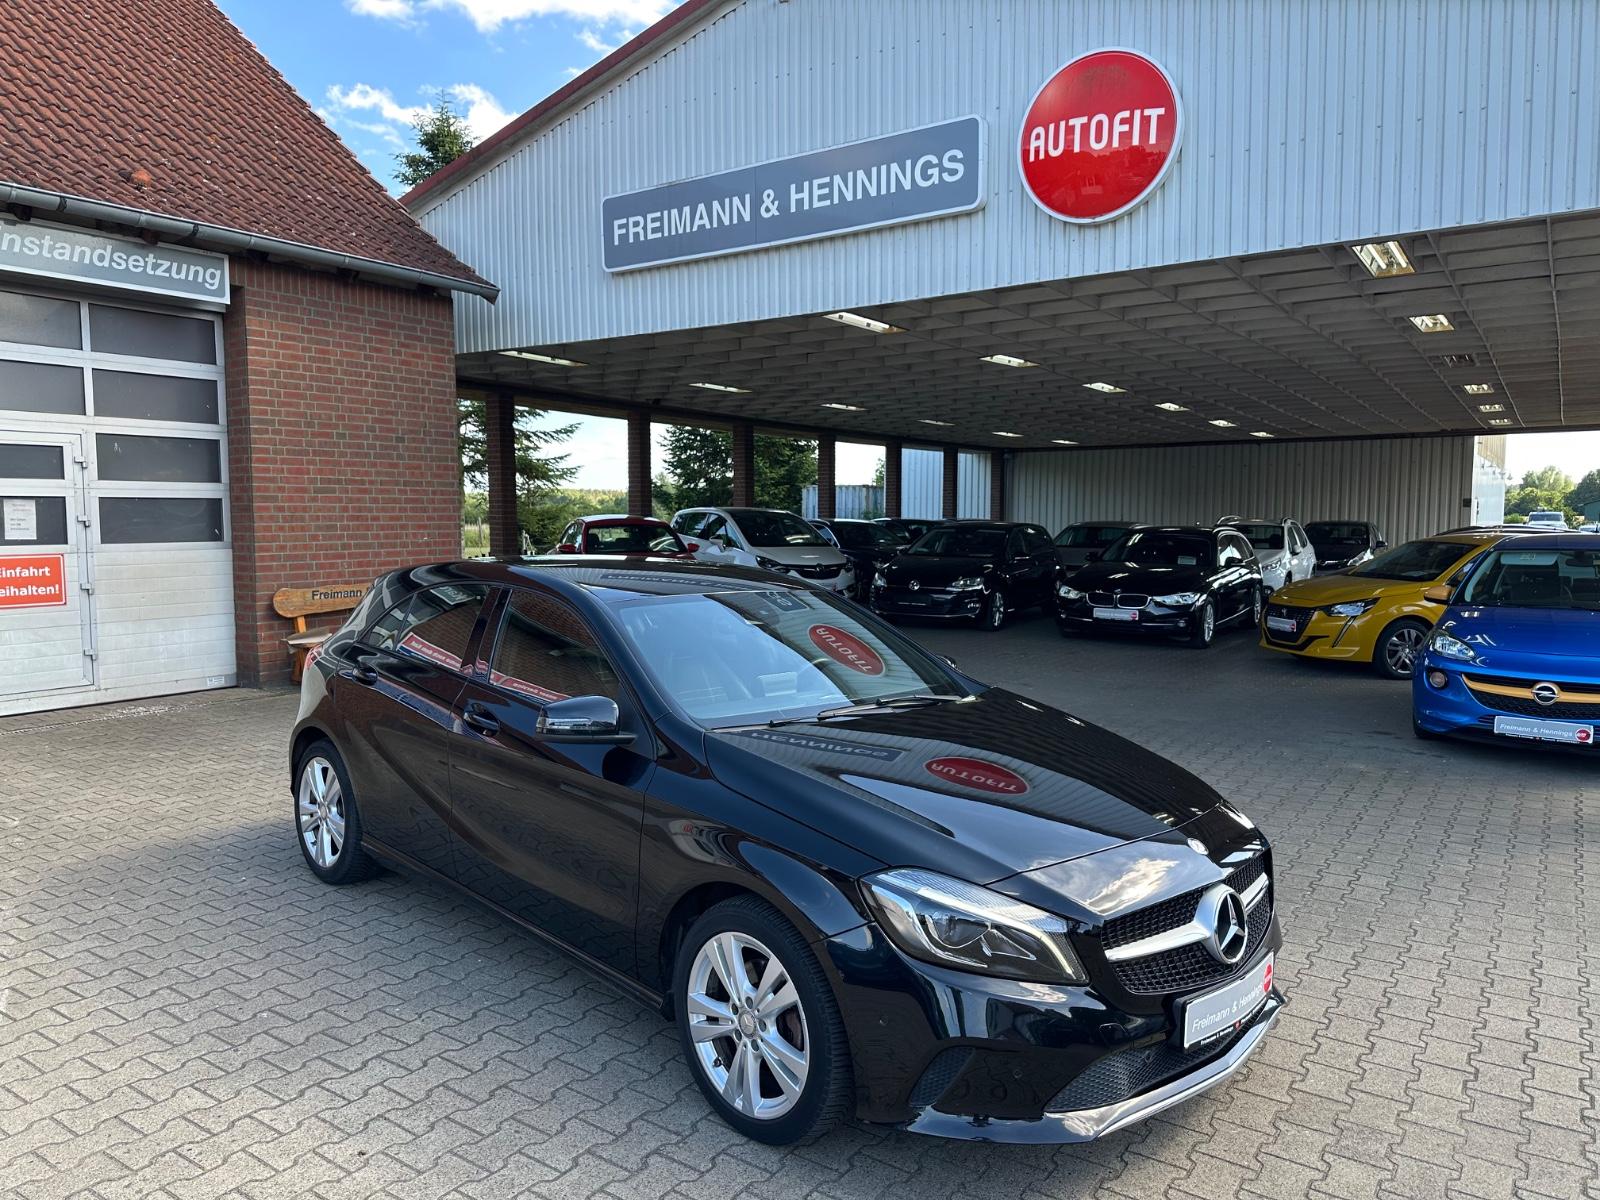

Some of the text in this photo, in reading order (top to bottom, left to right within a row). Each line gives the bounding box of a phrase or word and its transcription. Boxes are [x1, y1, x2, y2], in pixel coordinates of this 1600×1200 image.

[1029, 107, 1165, 162] AUTOFIT
[613, 149, 965, 245] FREIMANN & HENNINGS
[0, 226, 221, 290] nstandsetzung
[0, 566, 51, 578] infahrt
[311, 589, 363, 600] Freimann
[1500, 723, 1531, 733] Freimann
[1191, 1007, 1230, 1033] Freimann
